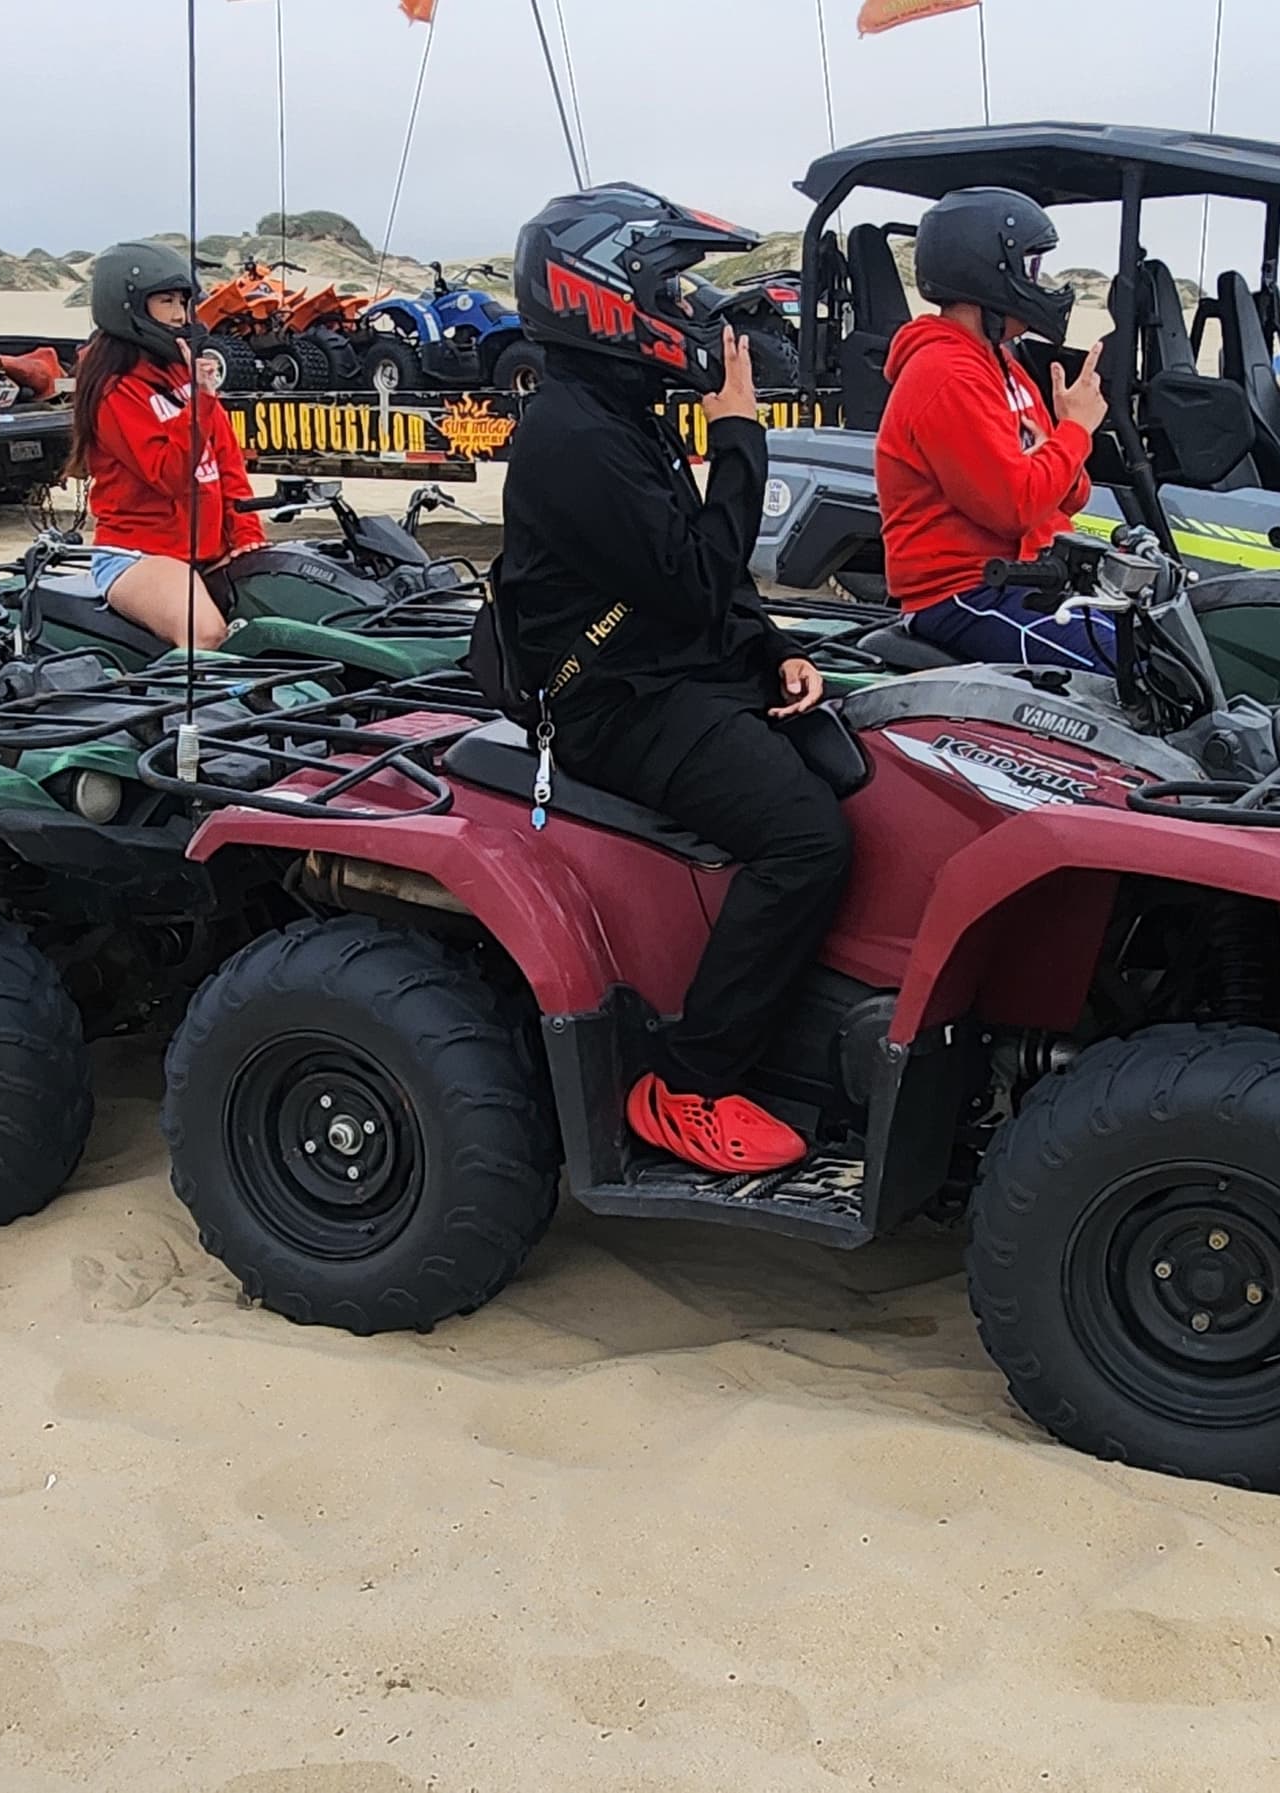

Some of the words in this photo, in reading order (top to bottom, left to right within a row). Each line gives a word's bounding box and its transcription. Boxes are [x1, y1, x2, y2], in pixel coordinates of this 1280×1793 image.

[444, 420, 467, 434] SUN
[472, 420, 513, 434] BUGGY
[584, 601, 632, 647] Henn
[1021, 705, 1091, 741] YAMAHA
[931, 735, 1100, 799] KODIAK
